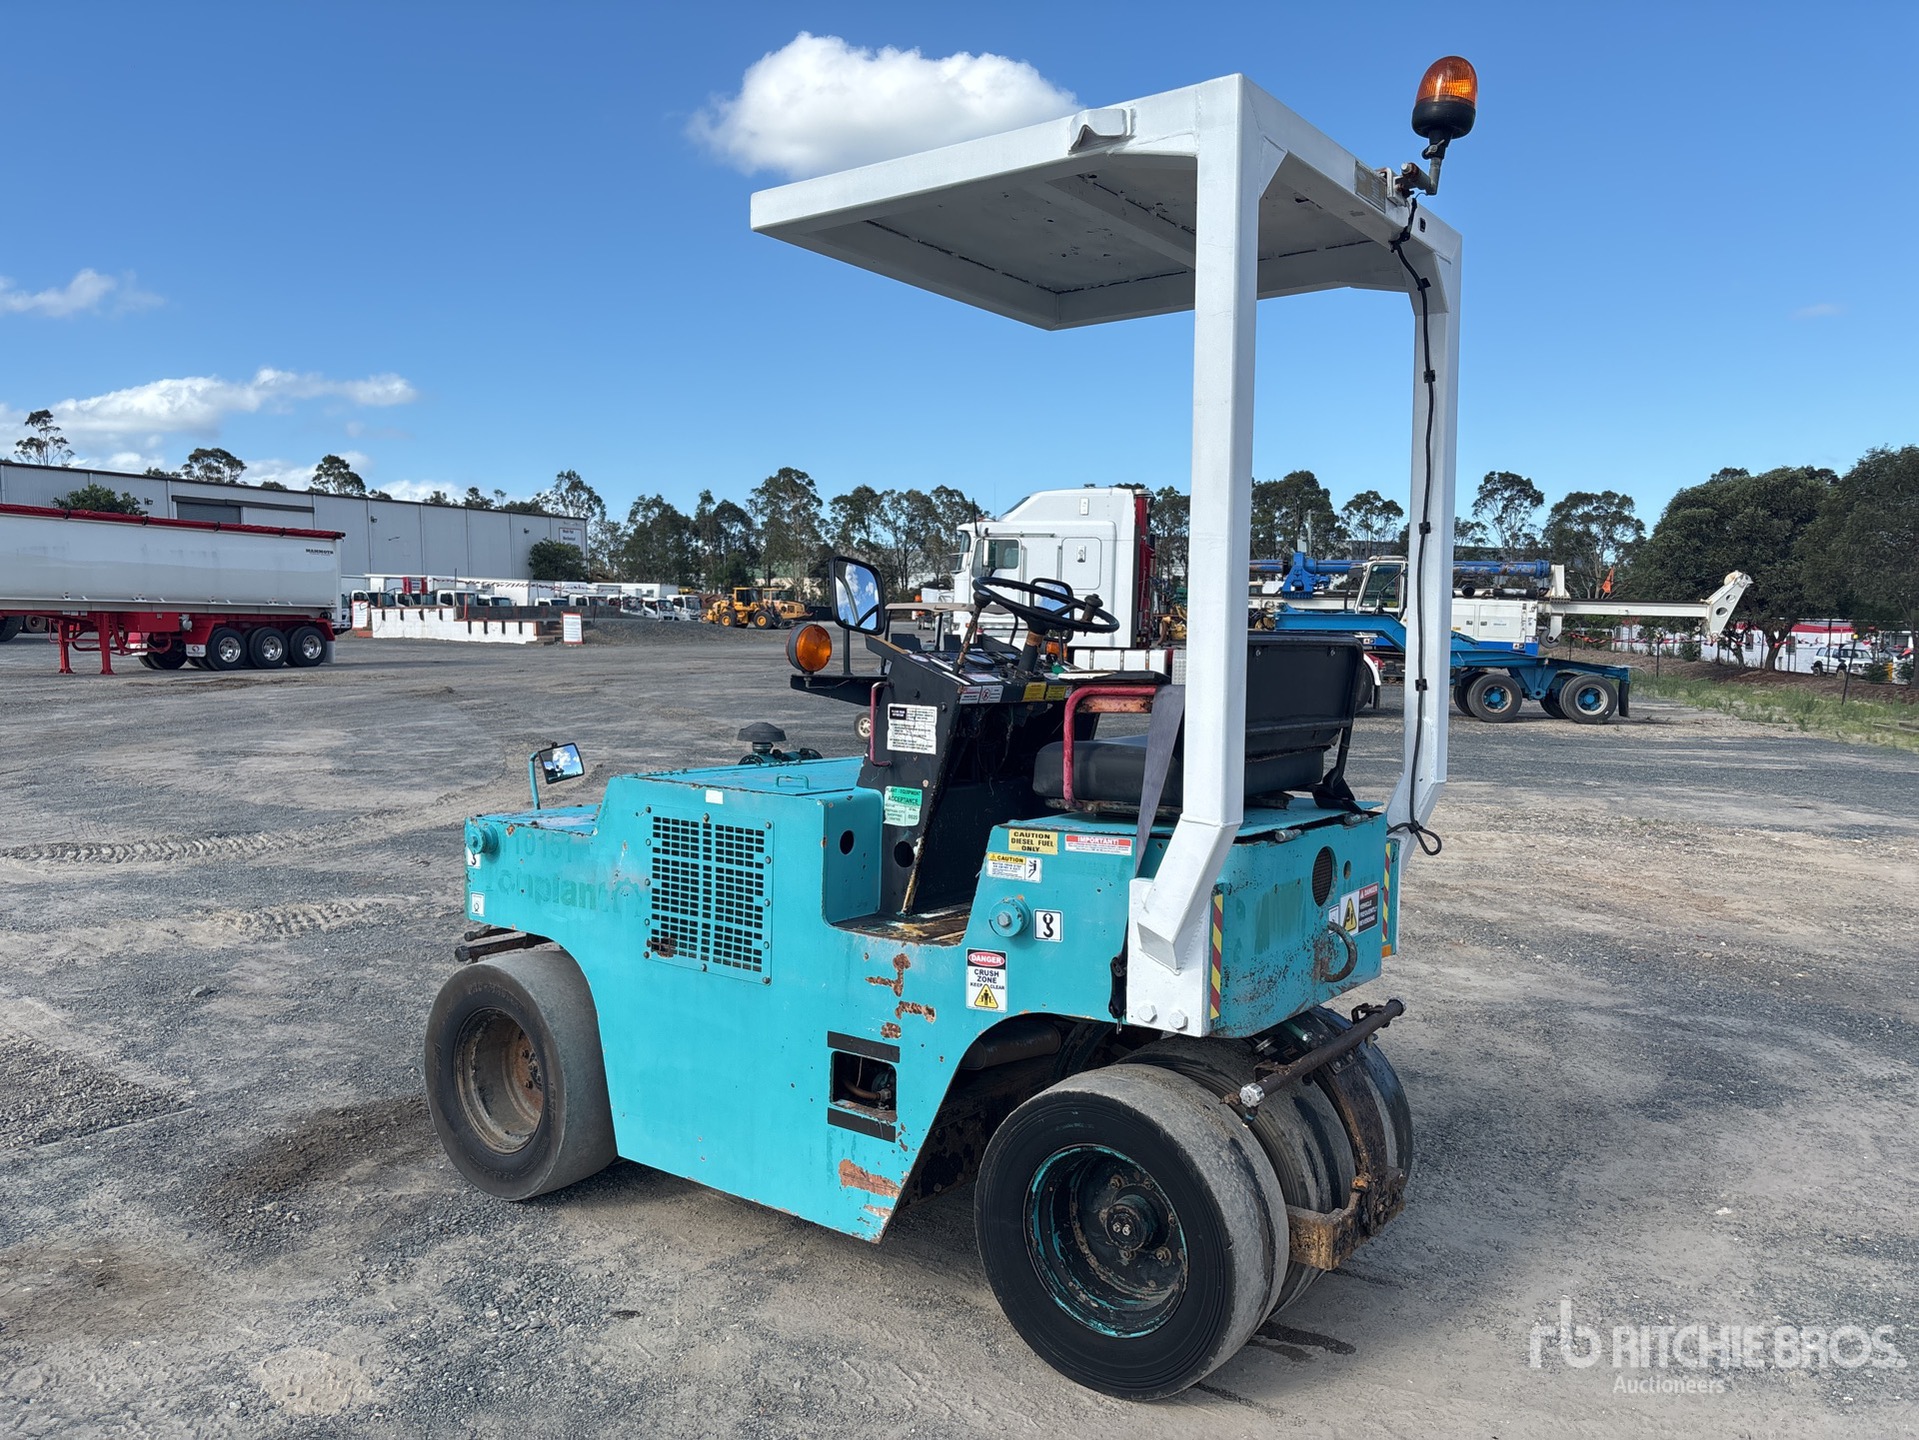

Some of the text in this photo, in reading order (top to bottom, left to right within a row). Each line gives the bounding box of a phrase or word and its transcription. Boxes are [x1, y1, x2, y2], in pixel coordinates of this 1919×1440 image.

[1013, 831, 1051, 839] CAUTION
[1011, 837, 1034, 845] DIESEL
[997, 855, 1024, 863] CAUTION
[971, 955, 1002, 964] DANGER
[974, 968, 1000, 977] CRUSH
[976, 976, 997, 984] ZONE
